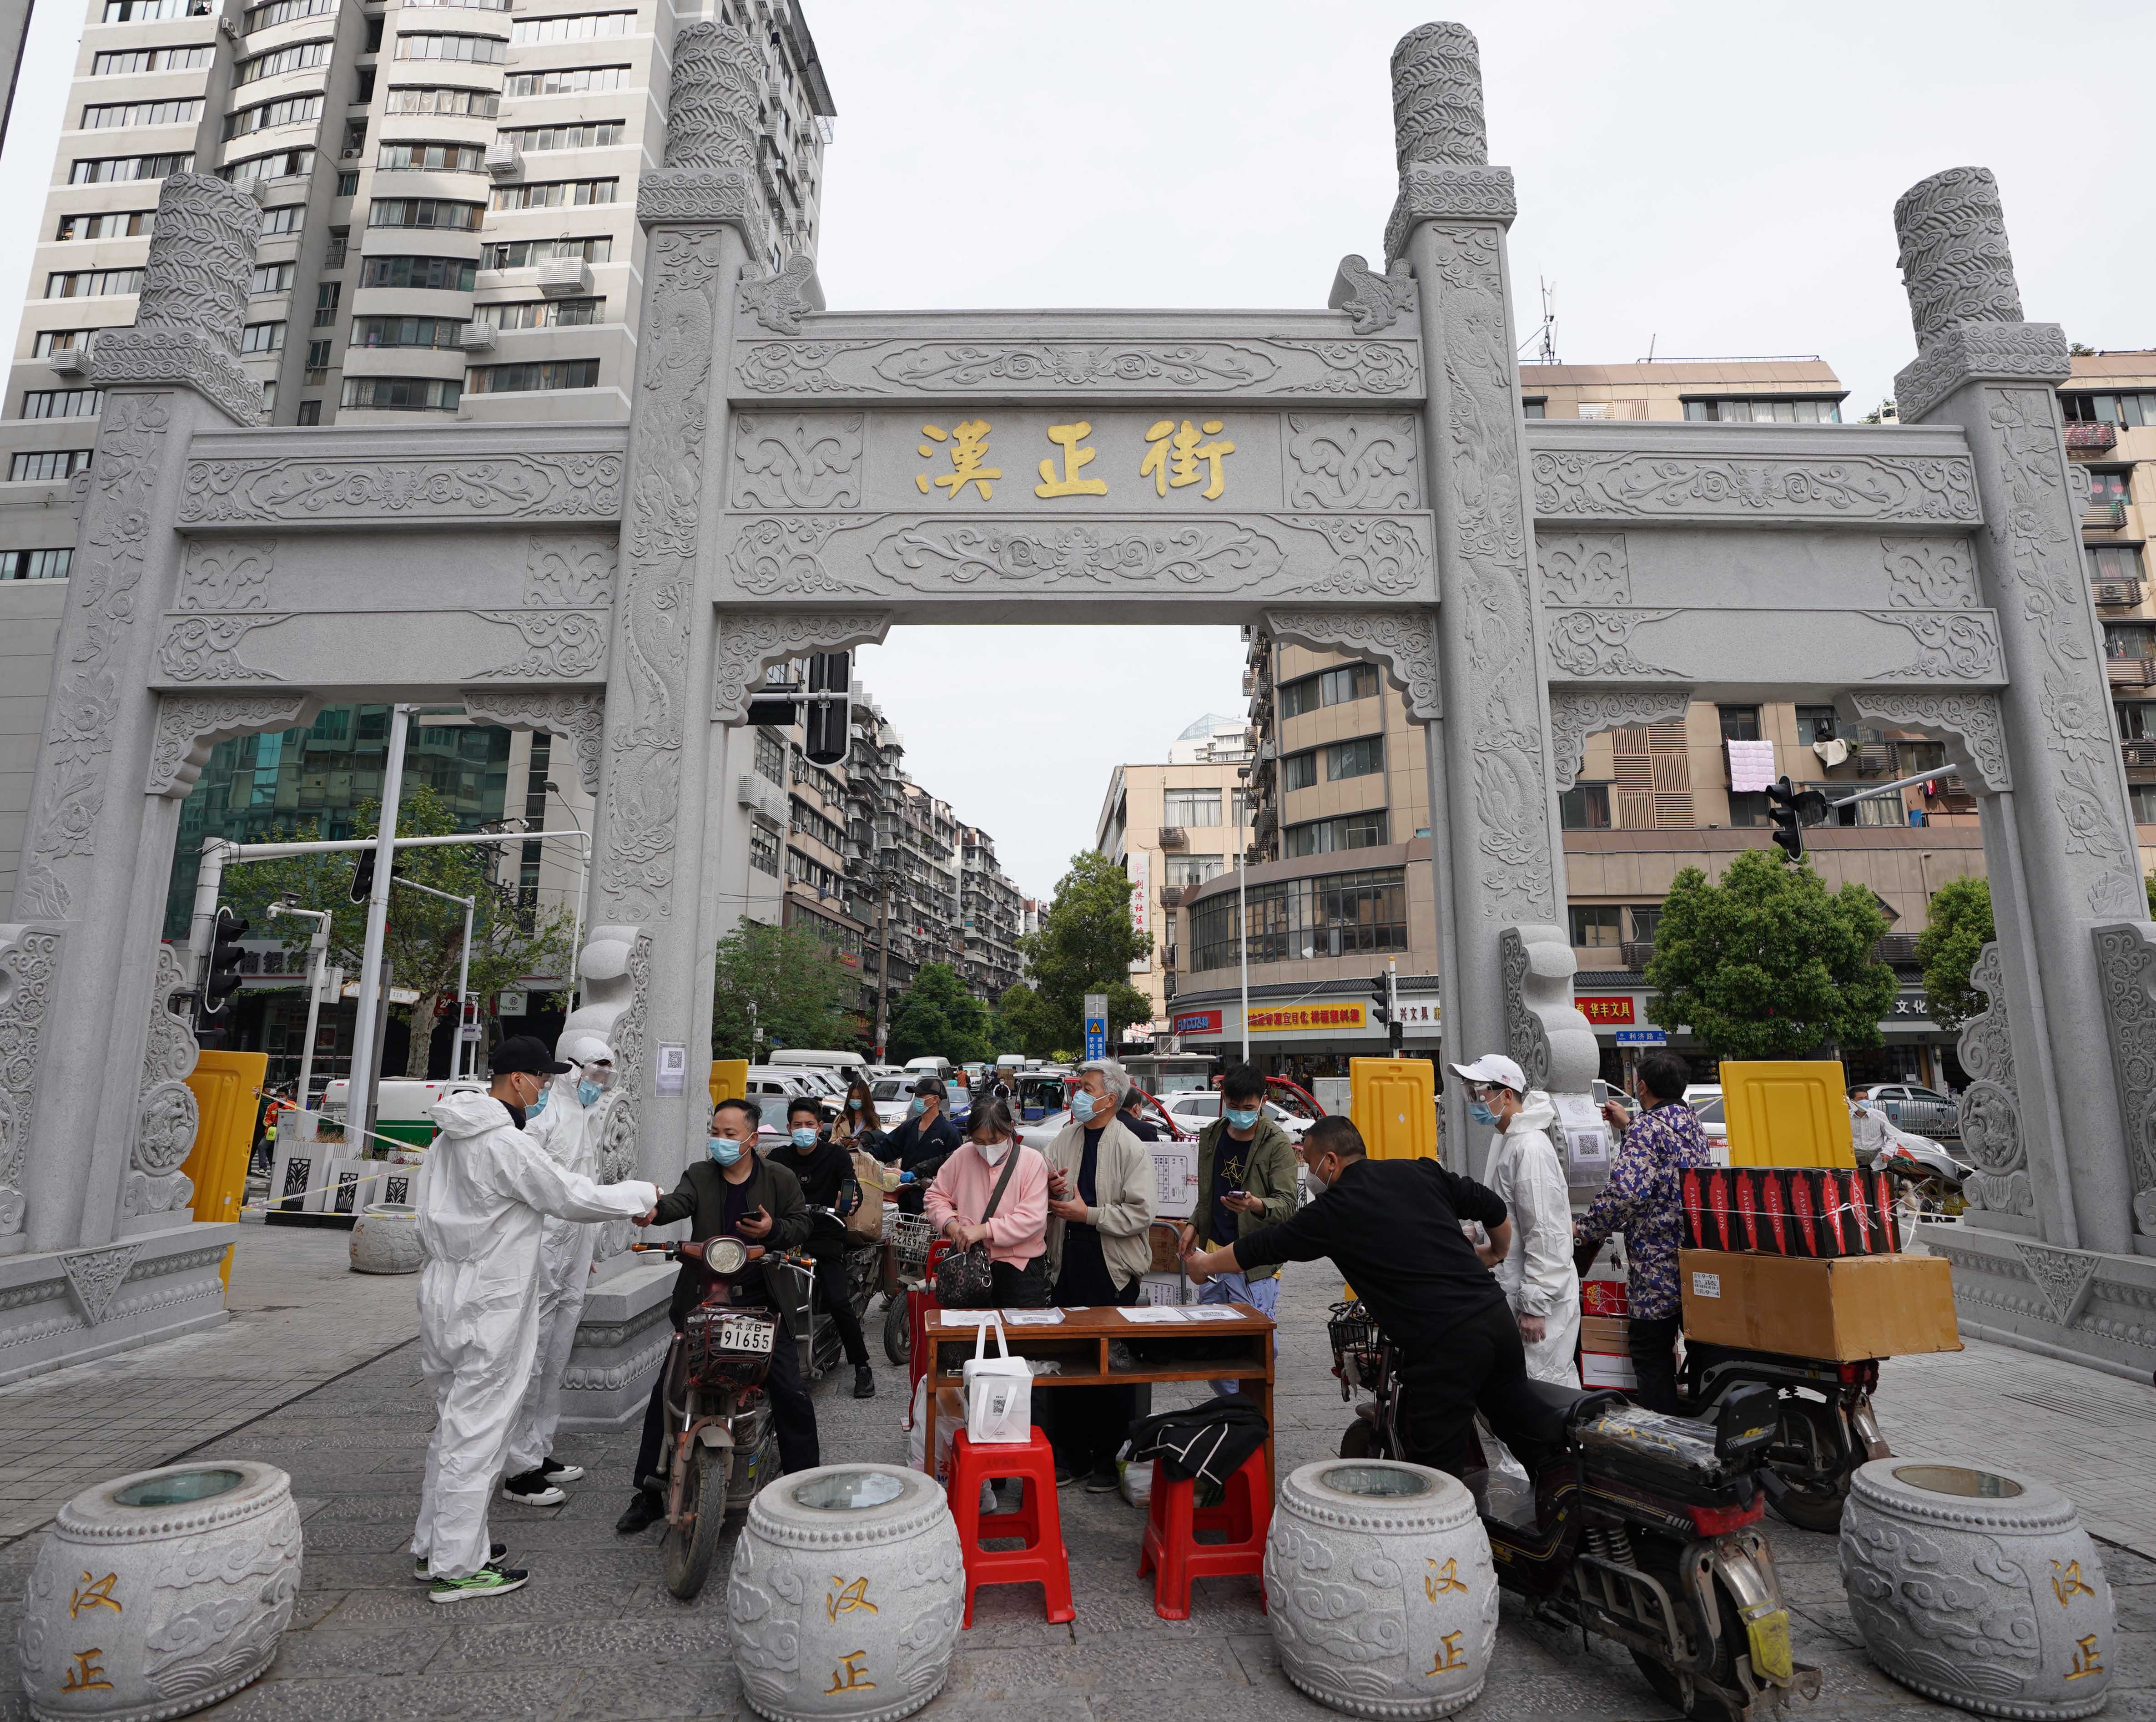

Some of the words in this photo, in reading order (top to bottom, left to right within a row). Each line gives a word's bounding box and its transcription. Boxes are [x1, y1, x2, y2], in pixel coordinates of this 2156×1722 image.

[916, 419, 1235, 500] 漢正街
[1590, 1002, 1630, 1017] 华丰文具
[1895, 1000, 1927, 1014] 文化
[1629, 1032, 1653, 1040] 利济路
[1689, 1187, 1698, 1227] FASHION
[1716, 1189, 1725, 1230] FASHION
[1742, 1190, 1753, 1231] FASHION
[1770, 1191, 1781, 1233] FASHION
[1798, 1191, 1811, 1234] FASHION
[725, 1330, 770, 1349] 91655
[60, 1571, 122, 1694] 汉正
[824, 1576, 878, 1696] 汉正
[1425, 1557, 1468, 1677] 汉正
[2052, 1560, 2102, 1680] 汉正
